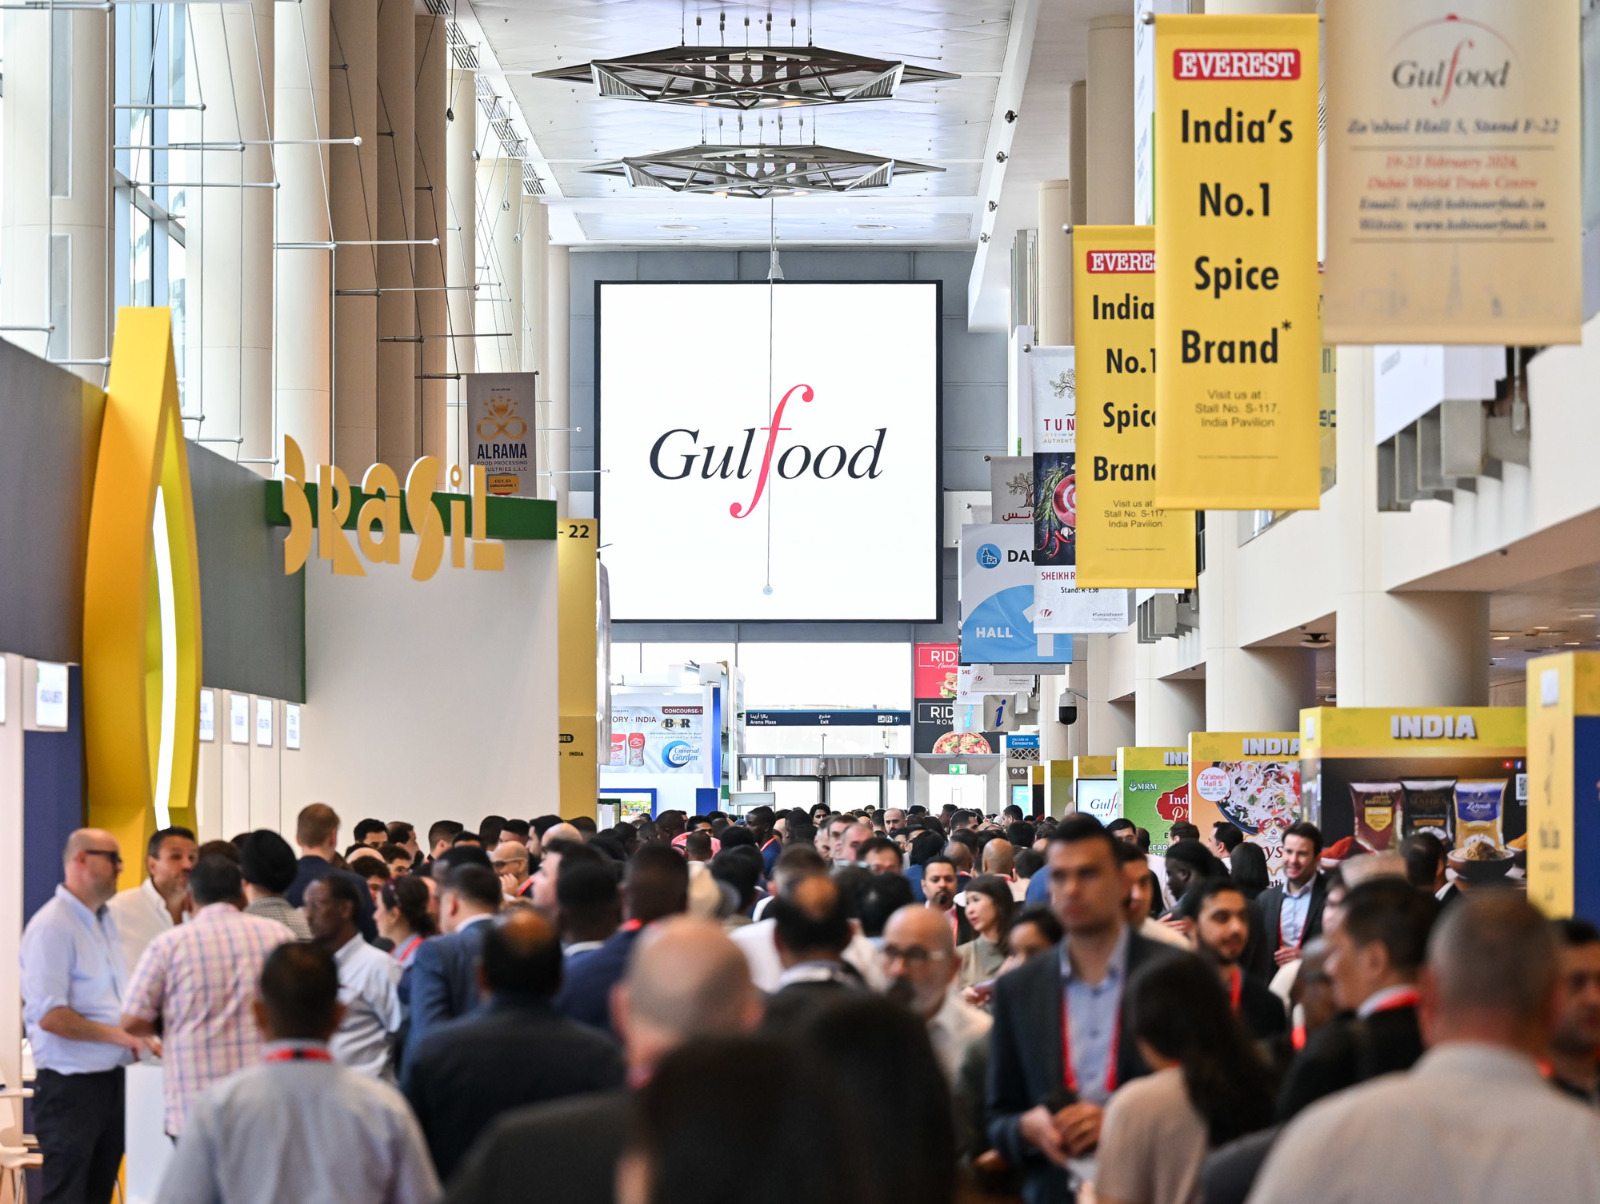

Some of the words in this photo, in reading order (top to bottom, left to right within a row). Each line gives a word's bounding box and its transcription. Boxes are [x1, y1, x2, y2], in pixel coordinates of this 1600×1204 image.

[1179, 51, 1296, 78] EVEREST
[1392, 39, 1511, 106] Gulfood
[1181, 107, 1293, 144] India’s
[1199, 182, 1271, 217] No.1
[1195, 256, 1279, 298] Spice
[1106, 348, 1156, 374] No.1
[1207, 389, 1231, 400] Visit
[1234, 391, 1247, 400] us
[1250, 390, 1262, 400] at
[1195, 403, 1219, 413] Stall
[1223, 403, 1241, 413] No.
[1201, 417, 1228, 427] India
[1231, 417, 1274, 427] Pavilion
[477, 443, 527, 459] ALRAMA
[650, 384, 887, 518] Gulfood
[1113, 500, 1130, 508] Visit
[1144, 500, 1153, 508] at
[1104, 510, 1122, 518] Stall
[1124, 510, 1138, 518] No.
[569, 524, 590, 539] 22
[1108, 520, 1128, 528] India
[1131, 520, 1163, 528] Pavilion
[1041, 571, 1069, 580] SHEIKH
[975, 627, 1014, 638] HALL
[1390, 714, 1477, 739] INDIA
